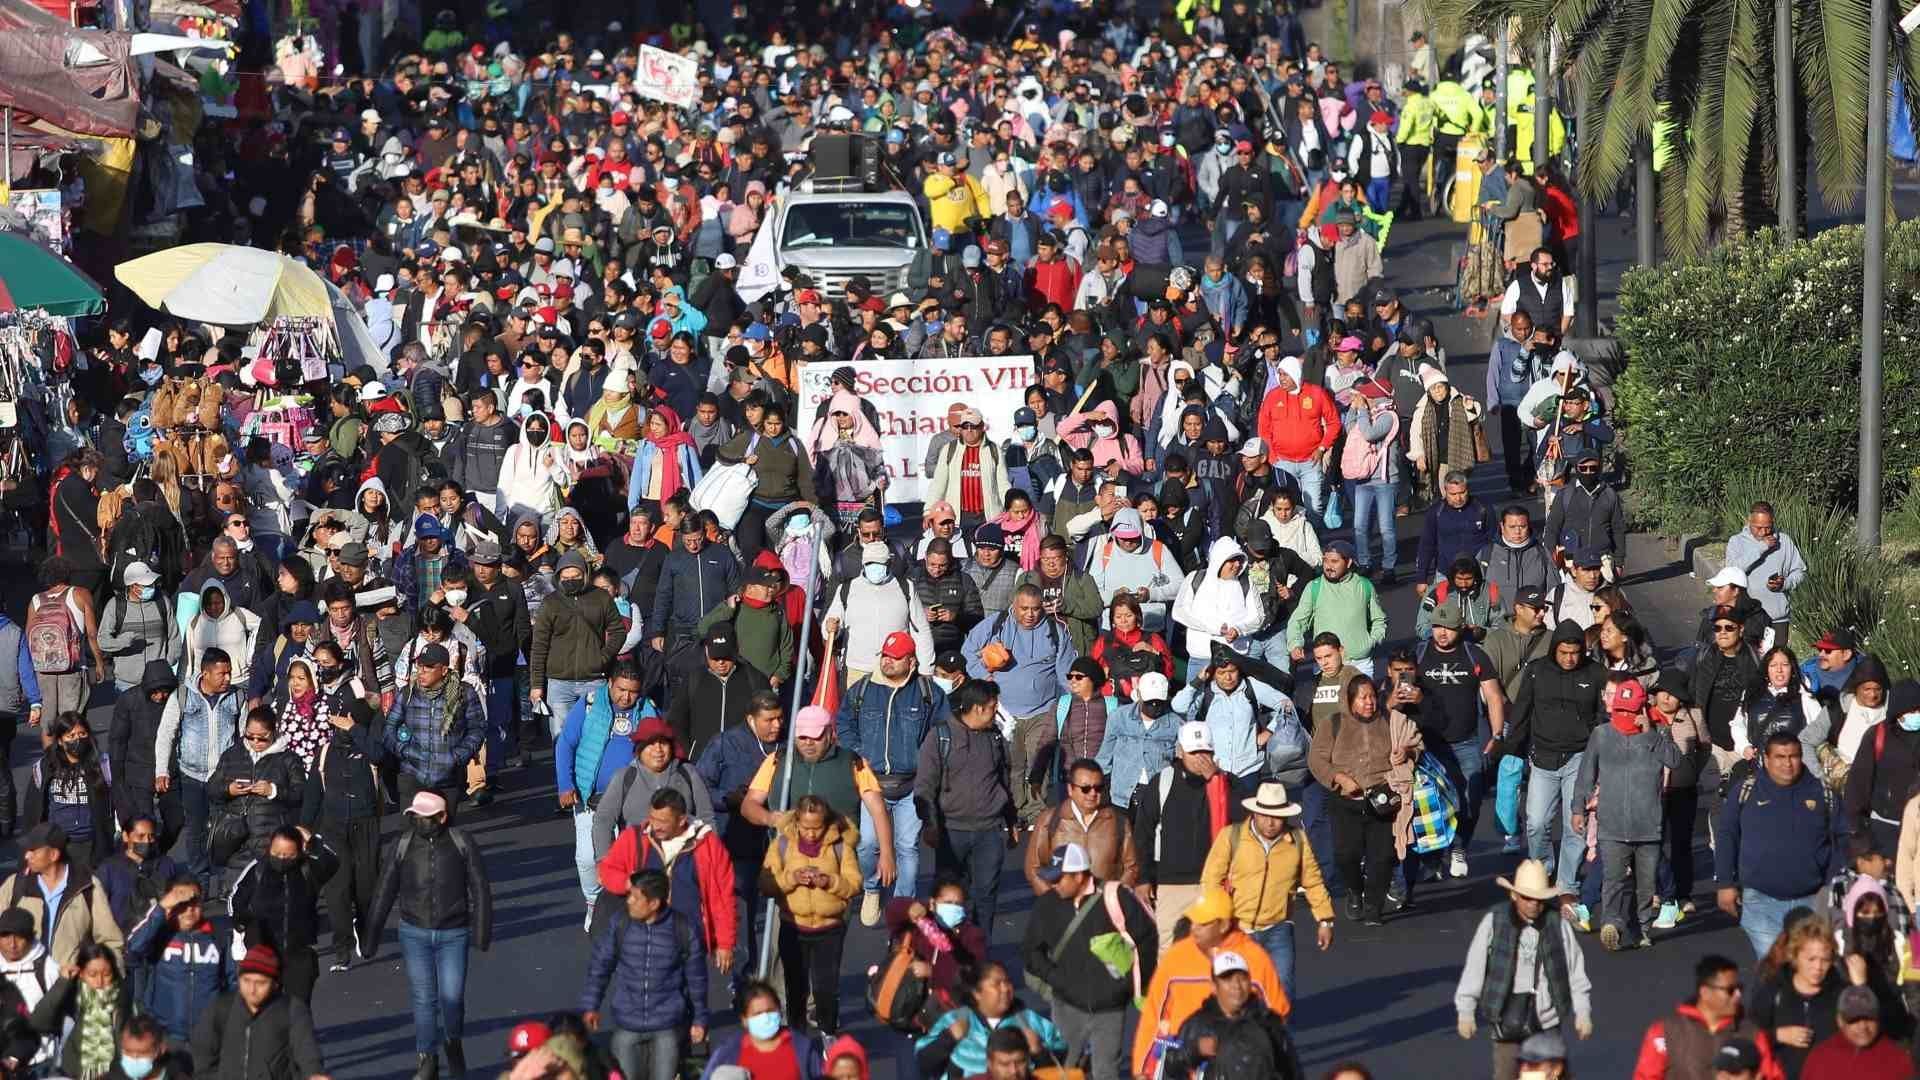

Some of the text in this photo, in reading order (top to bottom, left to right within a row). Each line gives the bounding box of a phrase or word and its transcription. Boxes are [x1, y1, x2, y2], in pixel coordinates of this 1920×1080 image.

[856, 370, 973, 396] Sección
[1198, 460, 1230, 480] GAP
[164, 940, 220, 964] FILA
